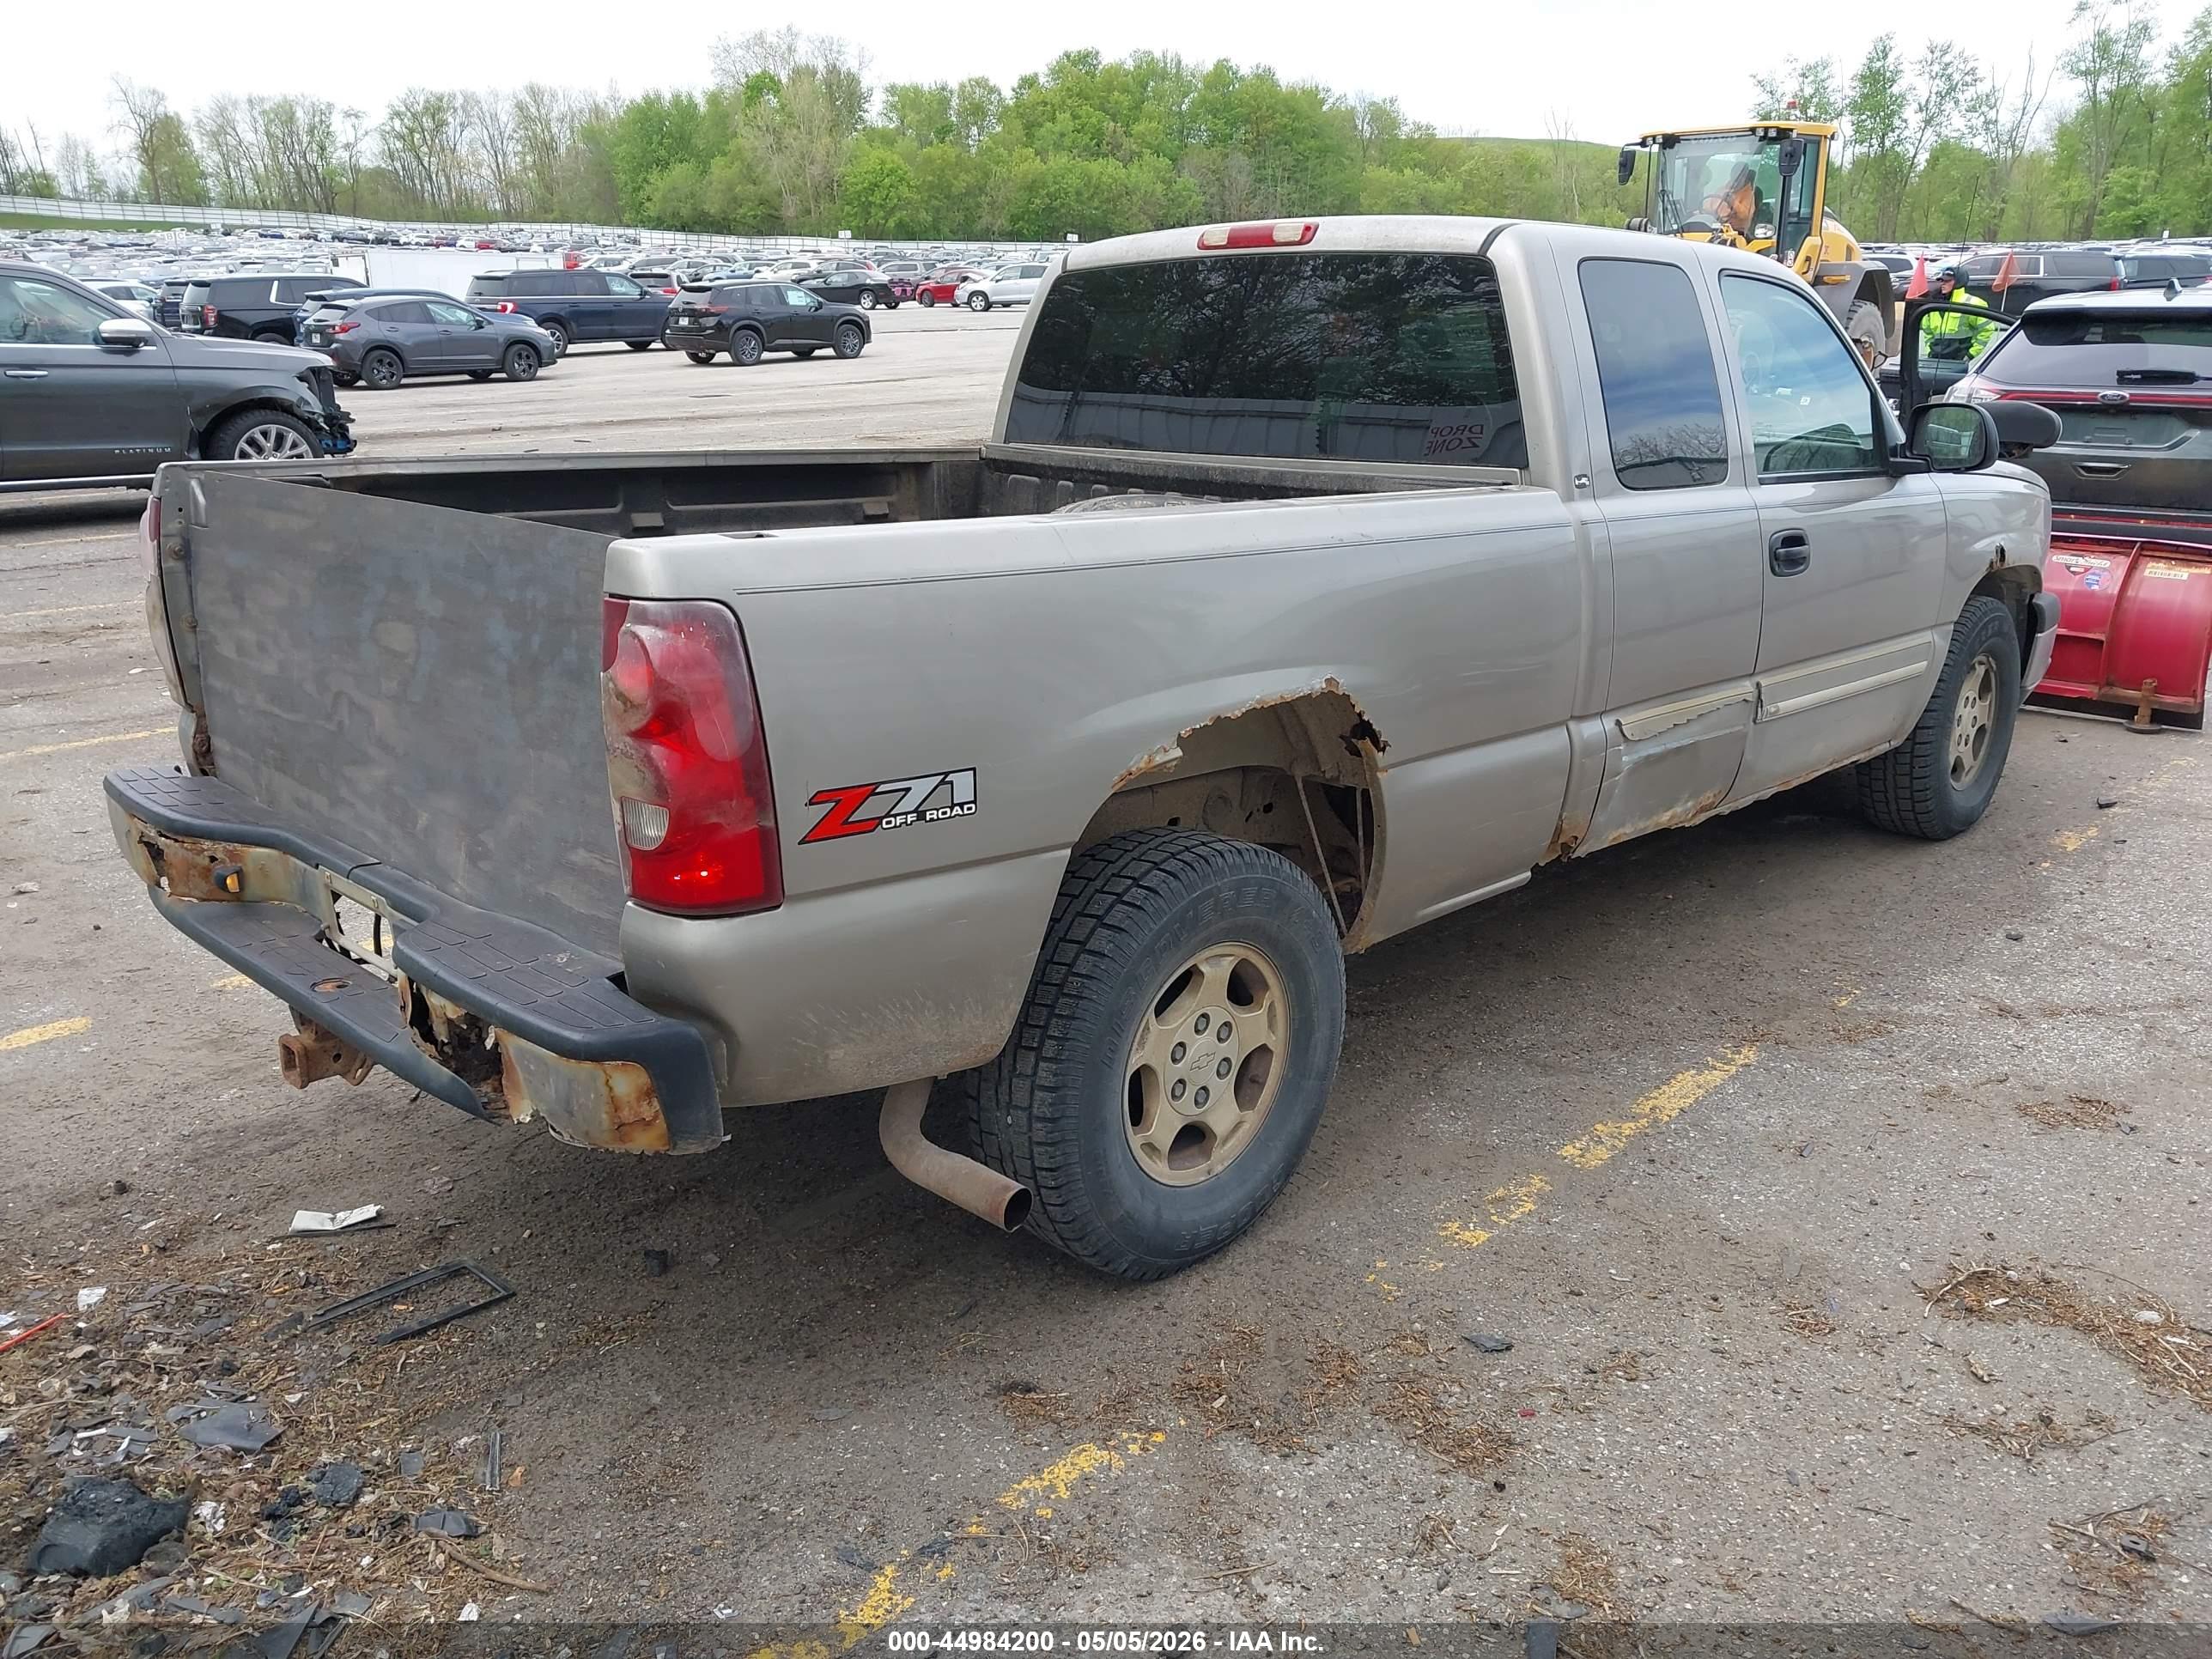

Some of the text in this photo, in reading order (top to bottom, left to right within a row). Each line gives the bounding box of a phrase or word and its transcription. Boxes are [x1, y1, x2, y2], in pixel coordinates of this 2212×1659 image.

[177, 232, 185, 240] C
[798, 767, 976, 845] Z71
[882, 803, 976, 830] OFF ROAD
